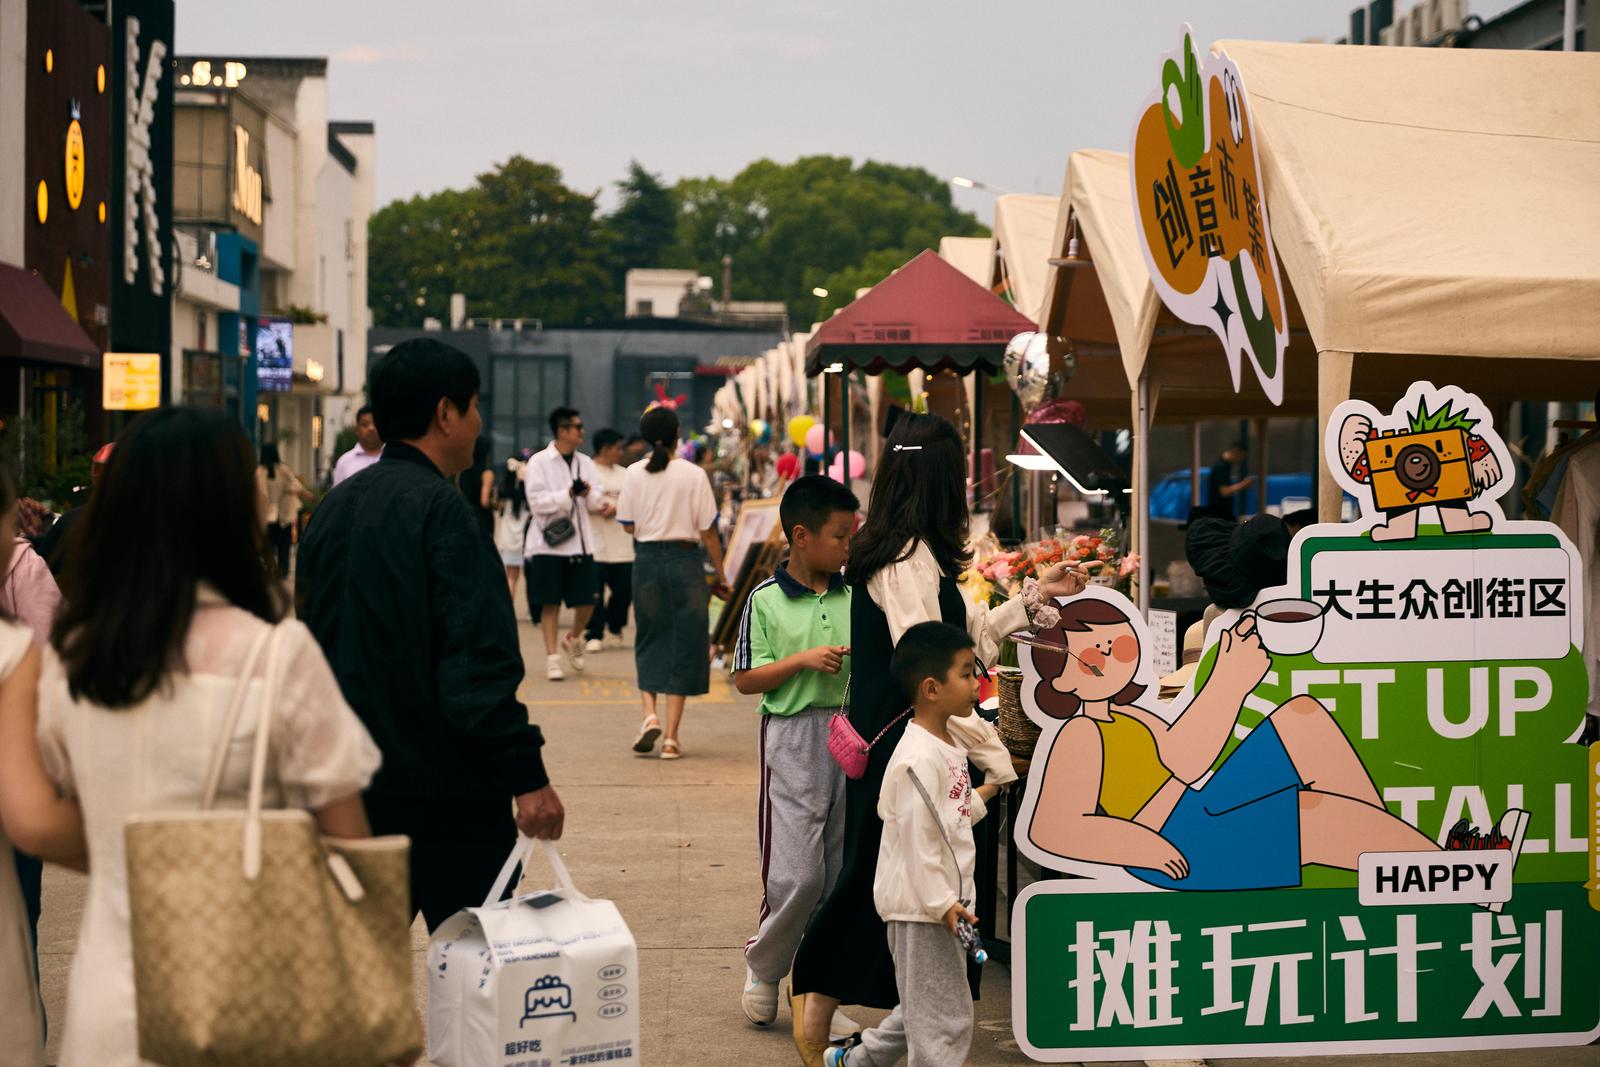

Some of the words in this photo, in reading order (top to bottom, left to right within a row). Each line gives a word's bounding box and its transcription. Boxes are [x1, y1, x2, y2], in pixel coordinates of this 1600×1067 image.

[1312, 577, 1567, 621] 大生众创街区
[1426, 665, 1553, 739] UP
[1375, 863, 1499, 894] HAPPY
[1067, 909, 1563, 1032] 摊玩计划
[504, 1039, 542, 1056] 超好吃
